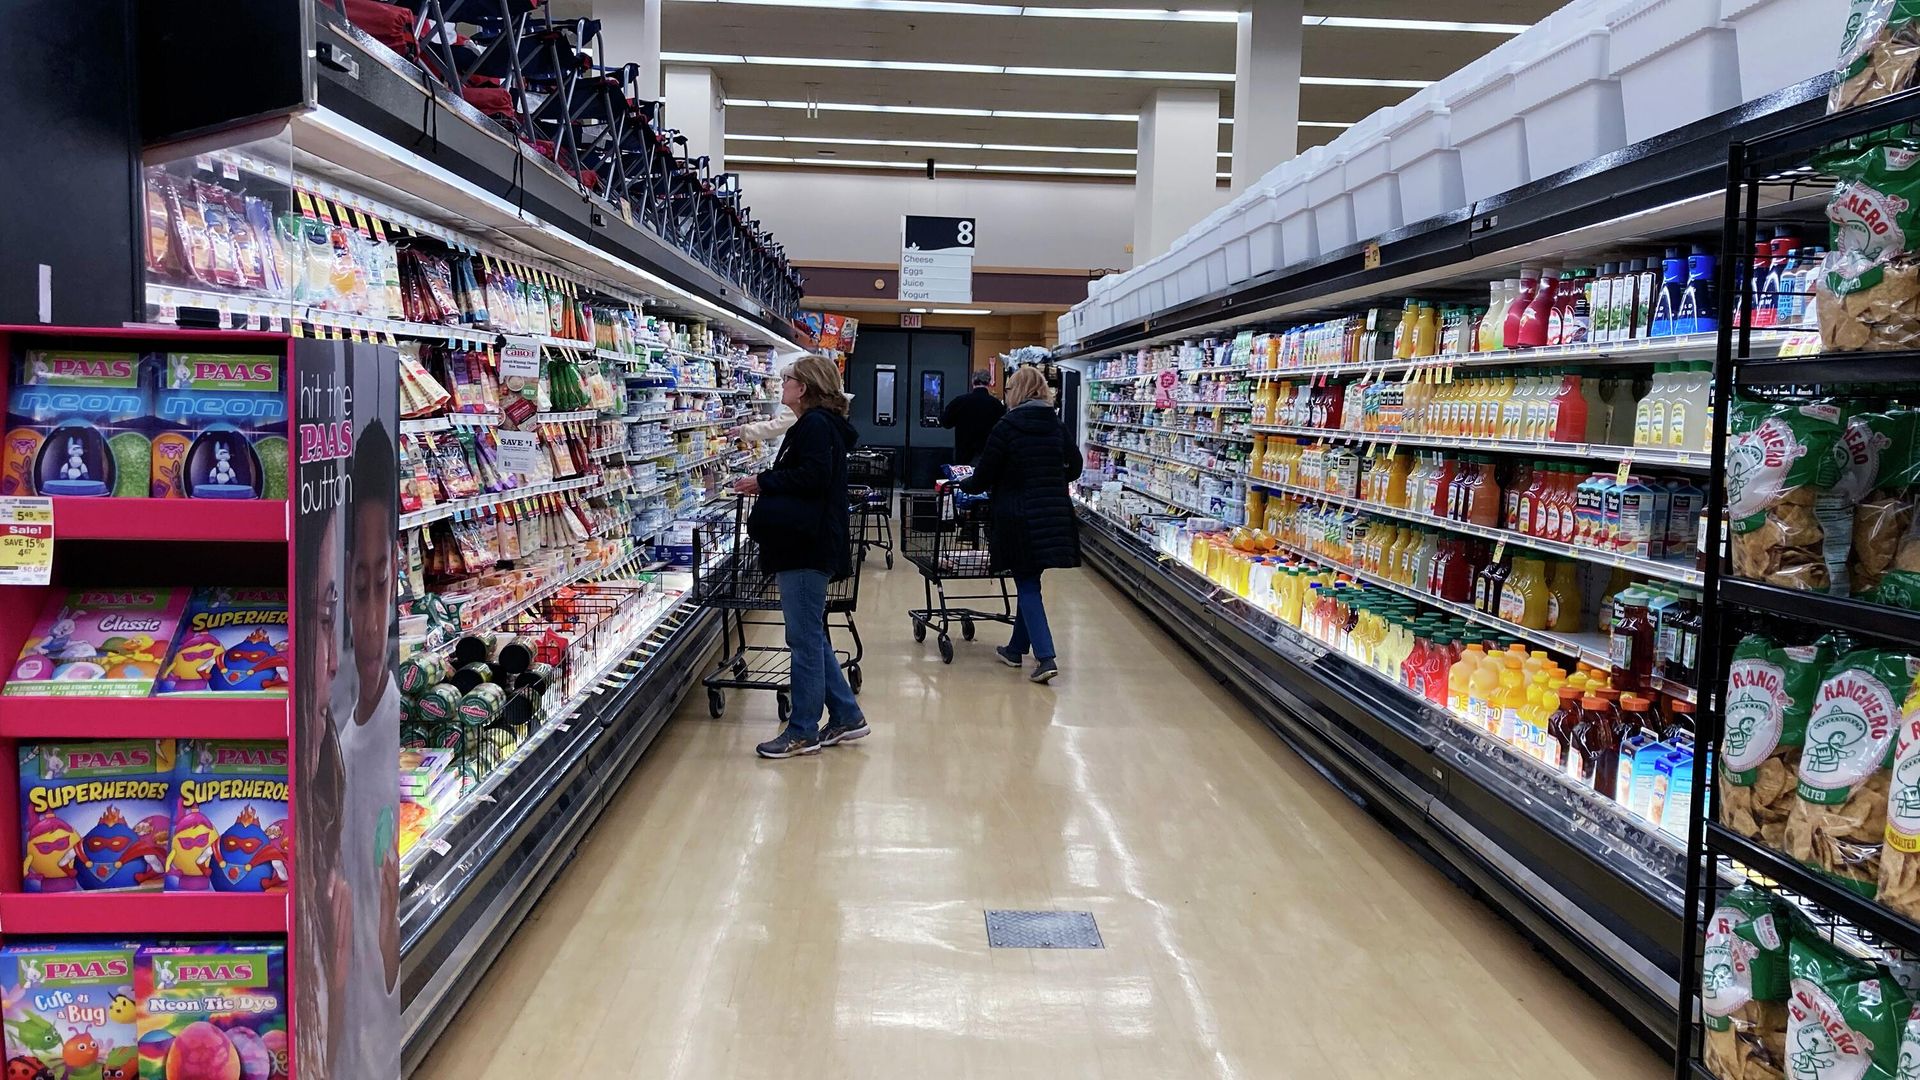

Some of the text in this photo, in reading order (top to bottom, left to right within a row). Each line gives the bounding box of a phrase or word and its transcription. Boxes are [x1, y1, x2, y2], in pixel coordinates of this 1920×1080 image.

[957, 220, 973, 245] 8
[903, 255, 934, 264] Cheese
[903, 267, 924, 276] Eggs
[902, 279, 924, 287] Juice
[902, 291, 929, 299] Yogurt
[903, 315, 920, 327] EXIT
[52, 359, 133, 378] PAAS
[193, 361, 273, 382] PAAS
[19, 393, 141, 413] neon
[300, 371, 353, 419] hit the
[164, 397, 284, 416] neon
[300, 419, 354, 465] PAAS
[500, 438, 524, 446] SAVE
[300, 465, 353, 515] button
[9, 525, 42, 534] Sale!
[4, 538, 23, 546] SAVE
[79, 591, 155, 605] PAAS
[98, 614, 161, 632] Classic
[192, 610, 288, 632] SUPERHER
[1823, 679, 1889, 740] RANCHERO
[67, 749, 150, 769] PAAS
[215, 748, 288, 767] PAAS
[29, 780, 169, 813] SUPERHEROES
[1798, 783, 1826, 801] SALTED
[44, 959, 128, 980] PAAS
[176, 963, 254, 981] PAAS
[34, 990, 89, 1012] Cute as
[149, 996, 278, 1014] Neon Tie Dye
[57, 1006, 107, 1026] a Bug
